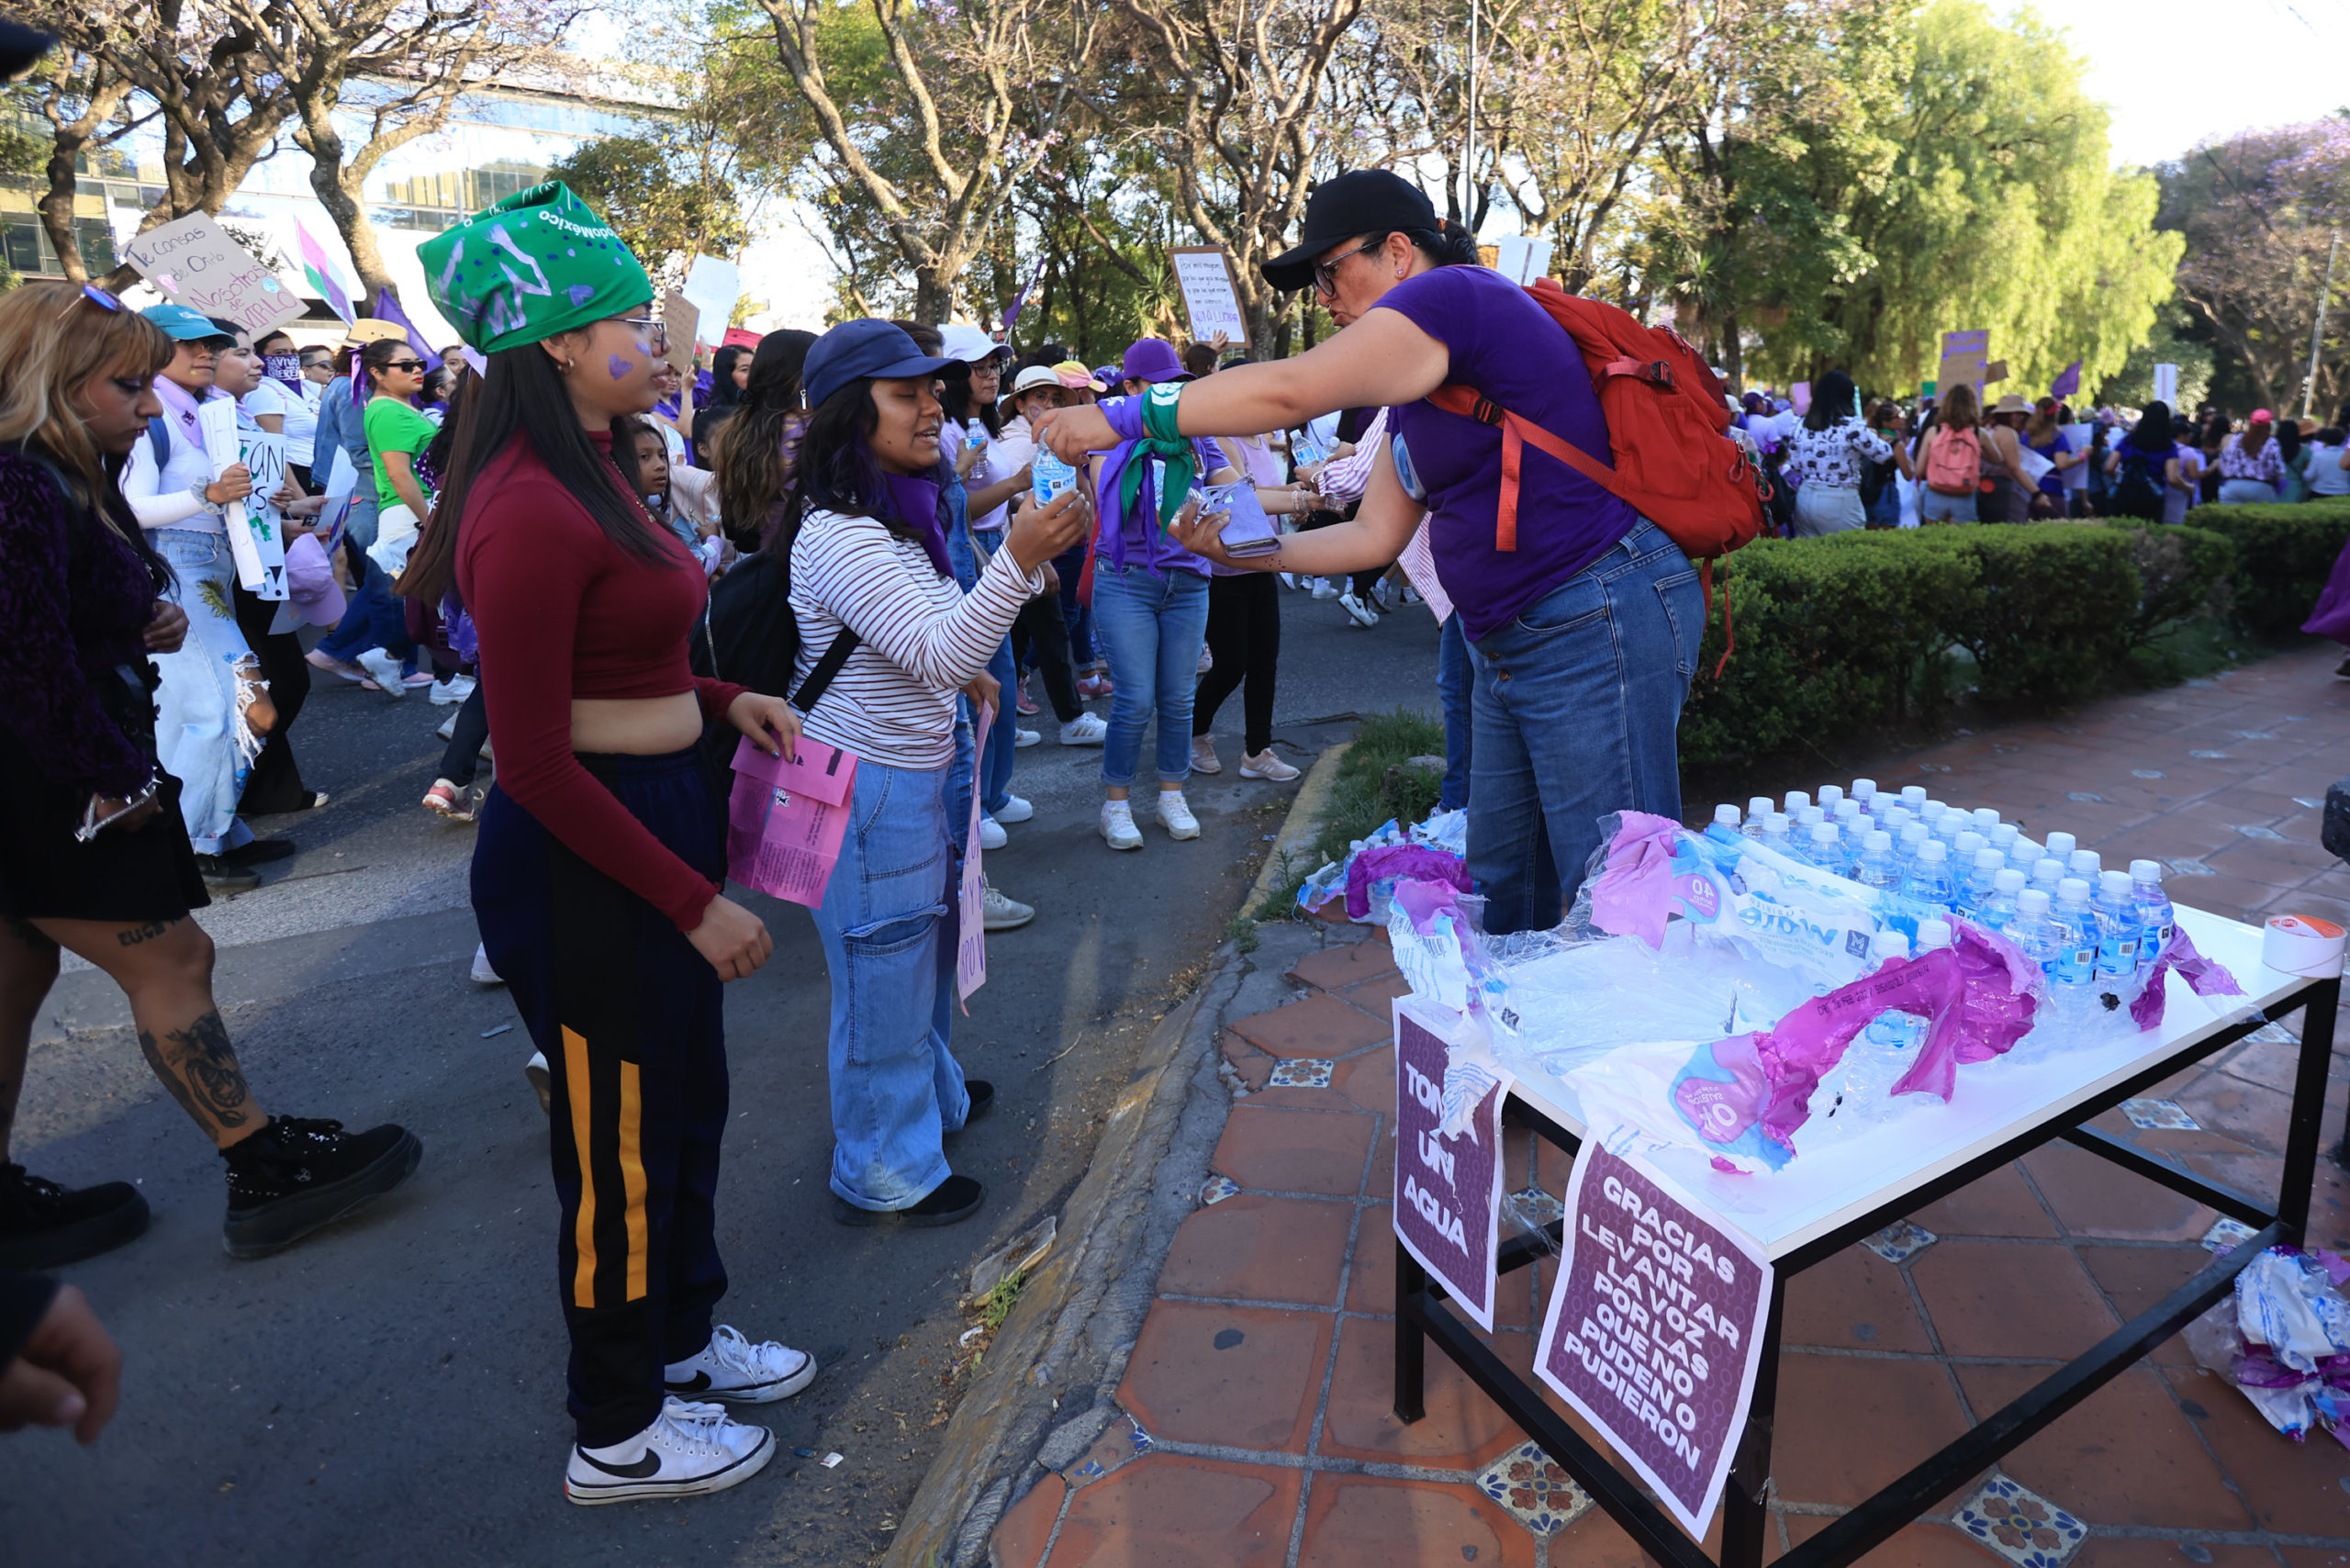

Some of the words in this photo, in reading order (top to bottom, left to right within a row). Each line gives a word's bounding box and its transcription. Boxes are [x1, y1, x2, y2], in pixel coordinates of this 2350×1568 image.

[125, 242, 155, 268] Te
[188, 263, 269, 312] Nosotras
[229, 296, 246, 312] de
[1418, 1129, 1455, 1187] UN
[1404, 1174, 1469, 1259] AGUA
[1603, 1176, 1735, 1283] GRACIAS
[1631, 1223, 1694, 1284] POR
[1583, 1214, 1740, 1350] LEVANTAR
[1594, 1271, 1650, 1332] POR
[1652, 1319, 1709, 1381] LAS
[1607, 1255, 1642, 1301] LA
[1650, 1286, 1706, 1350] VOZ
[1581, 1316, 1674, 1414] PUDEN
[1675, 1403, 1695, 1431] O
[1596, 1303, 1650, 1362] QUE
[1651, 1348, 1694, 1397] NO
[1564, 1331, 1700, 1472] PUDIERON
